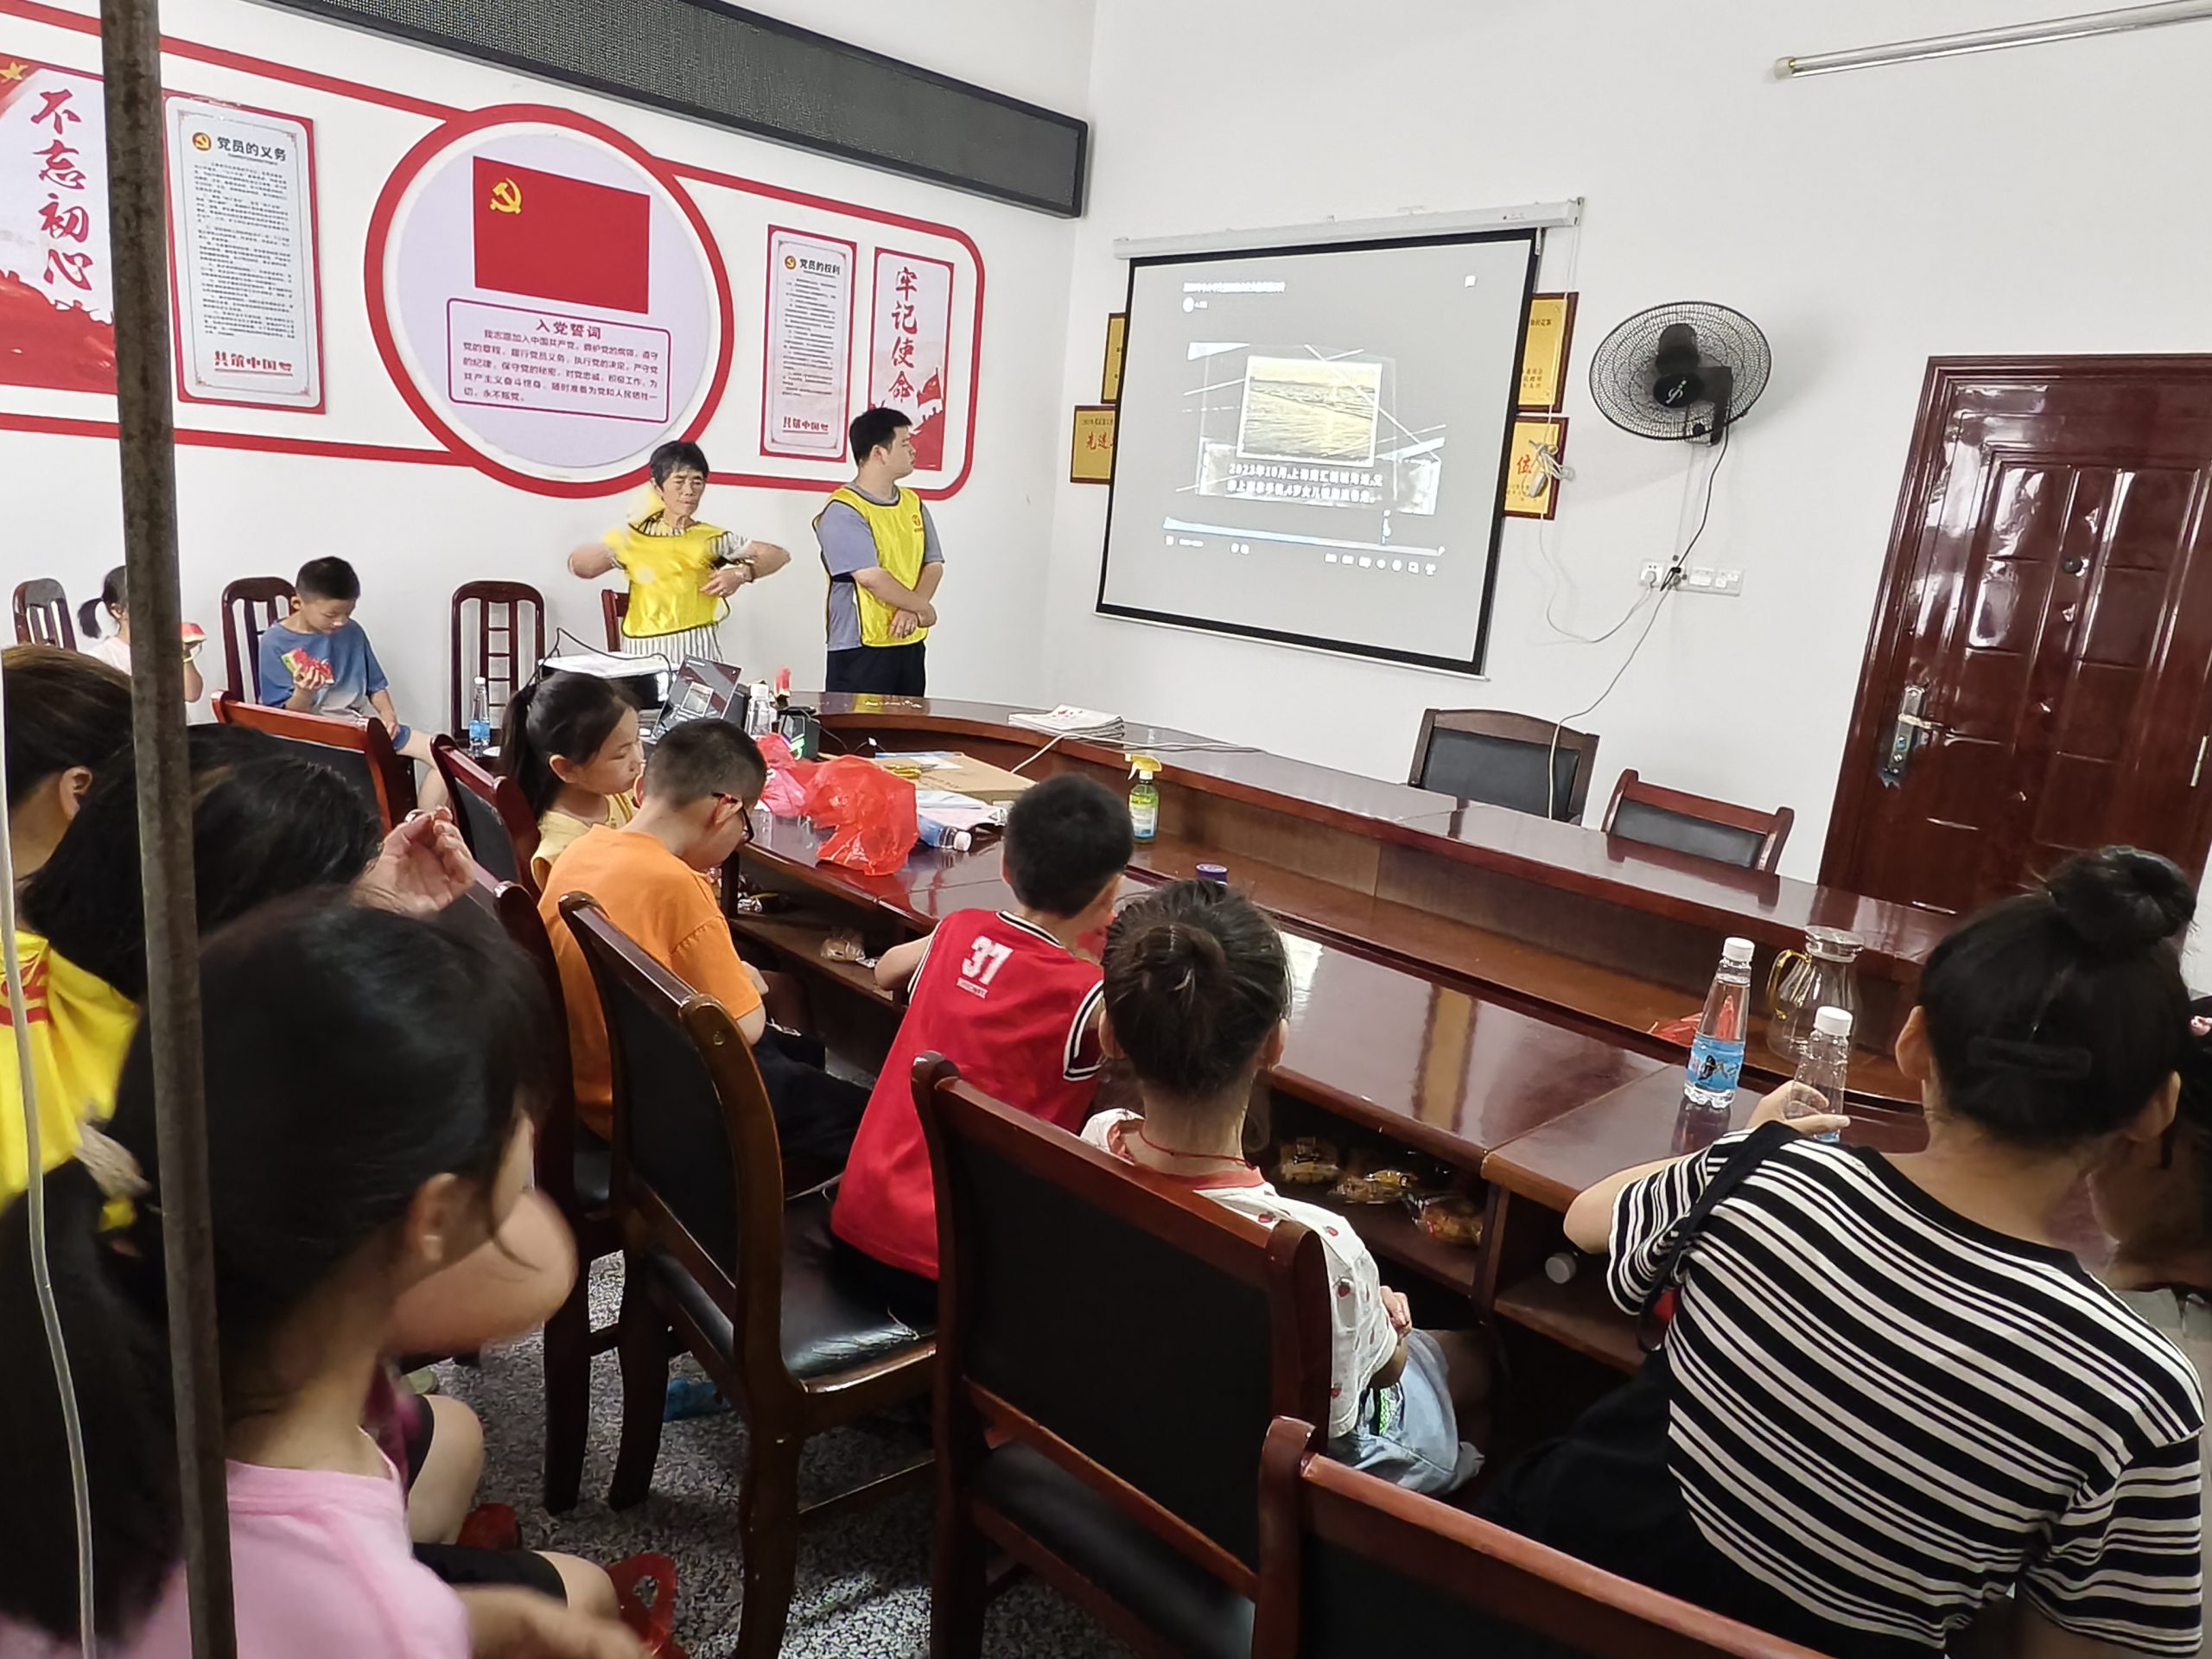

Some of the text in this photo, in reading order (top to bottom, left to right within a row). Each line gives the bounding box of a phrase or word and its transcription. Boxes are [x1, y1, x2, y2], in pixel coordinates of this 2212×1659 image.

[217, 137, 286, 162] 党员的义务
[30, 88, 93, 291] 不忘初心
[536, 319, 601, 340] 入党誓词
[888, 266, 918, 403] 牢记使命
[962, 935, 1014, 986] 37
